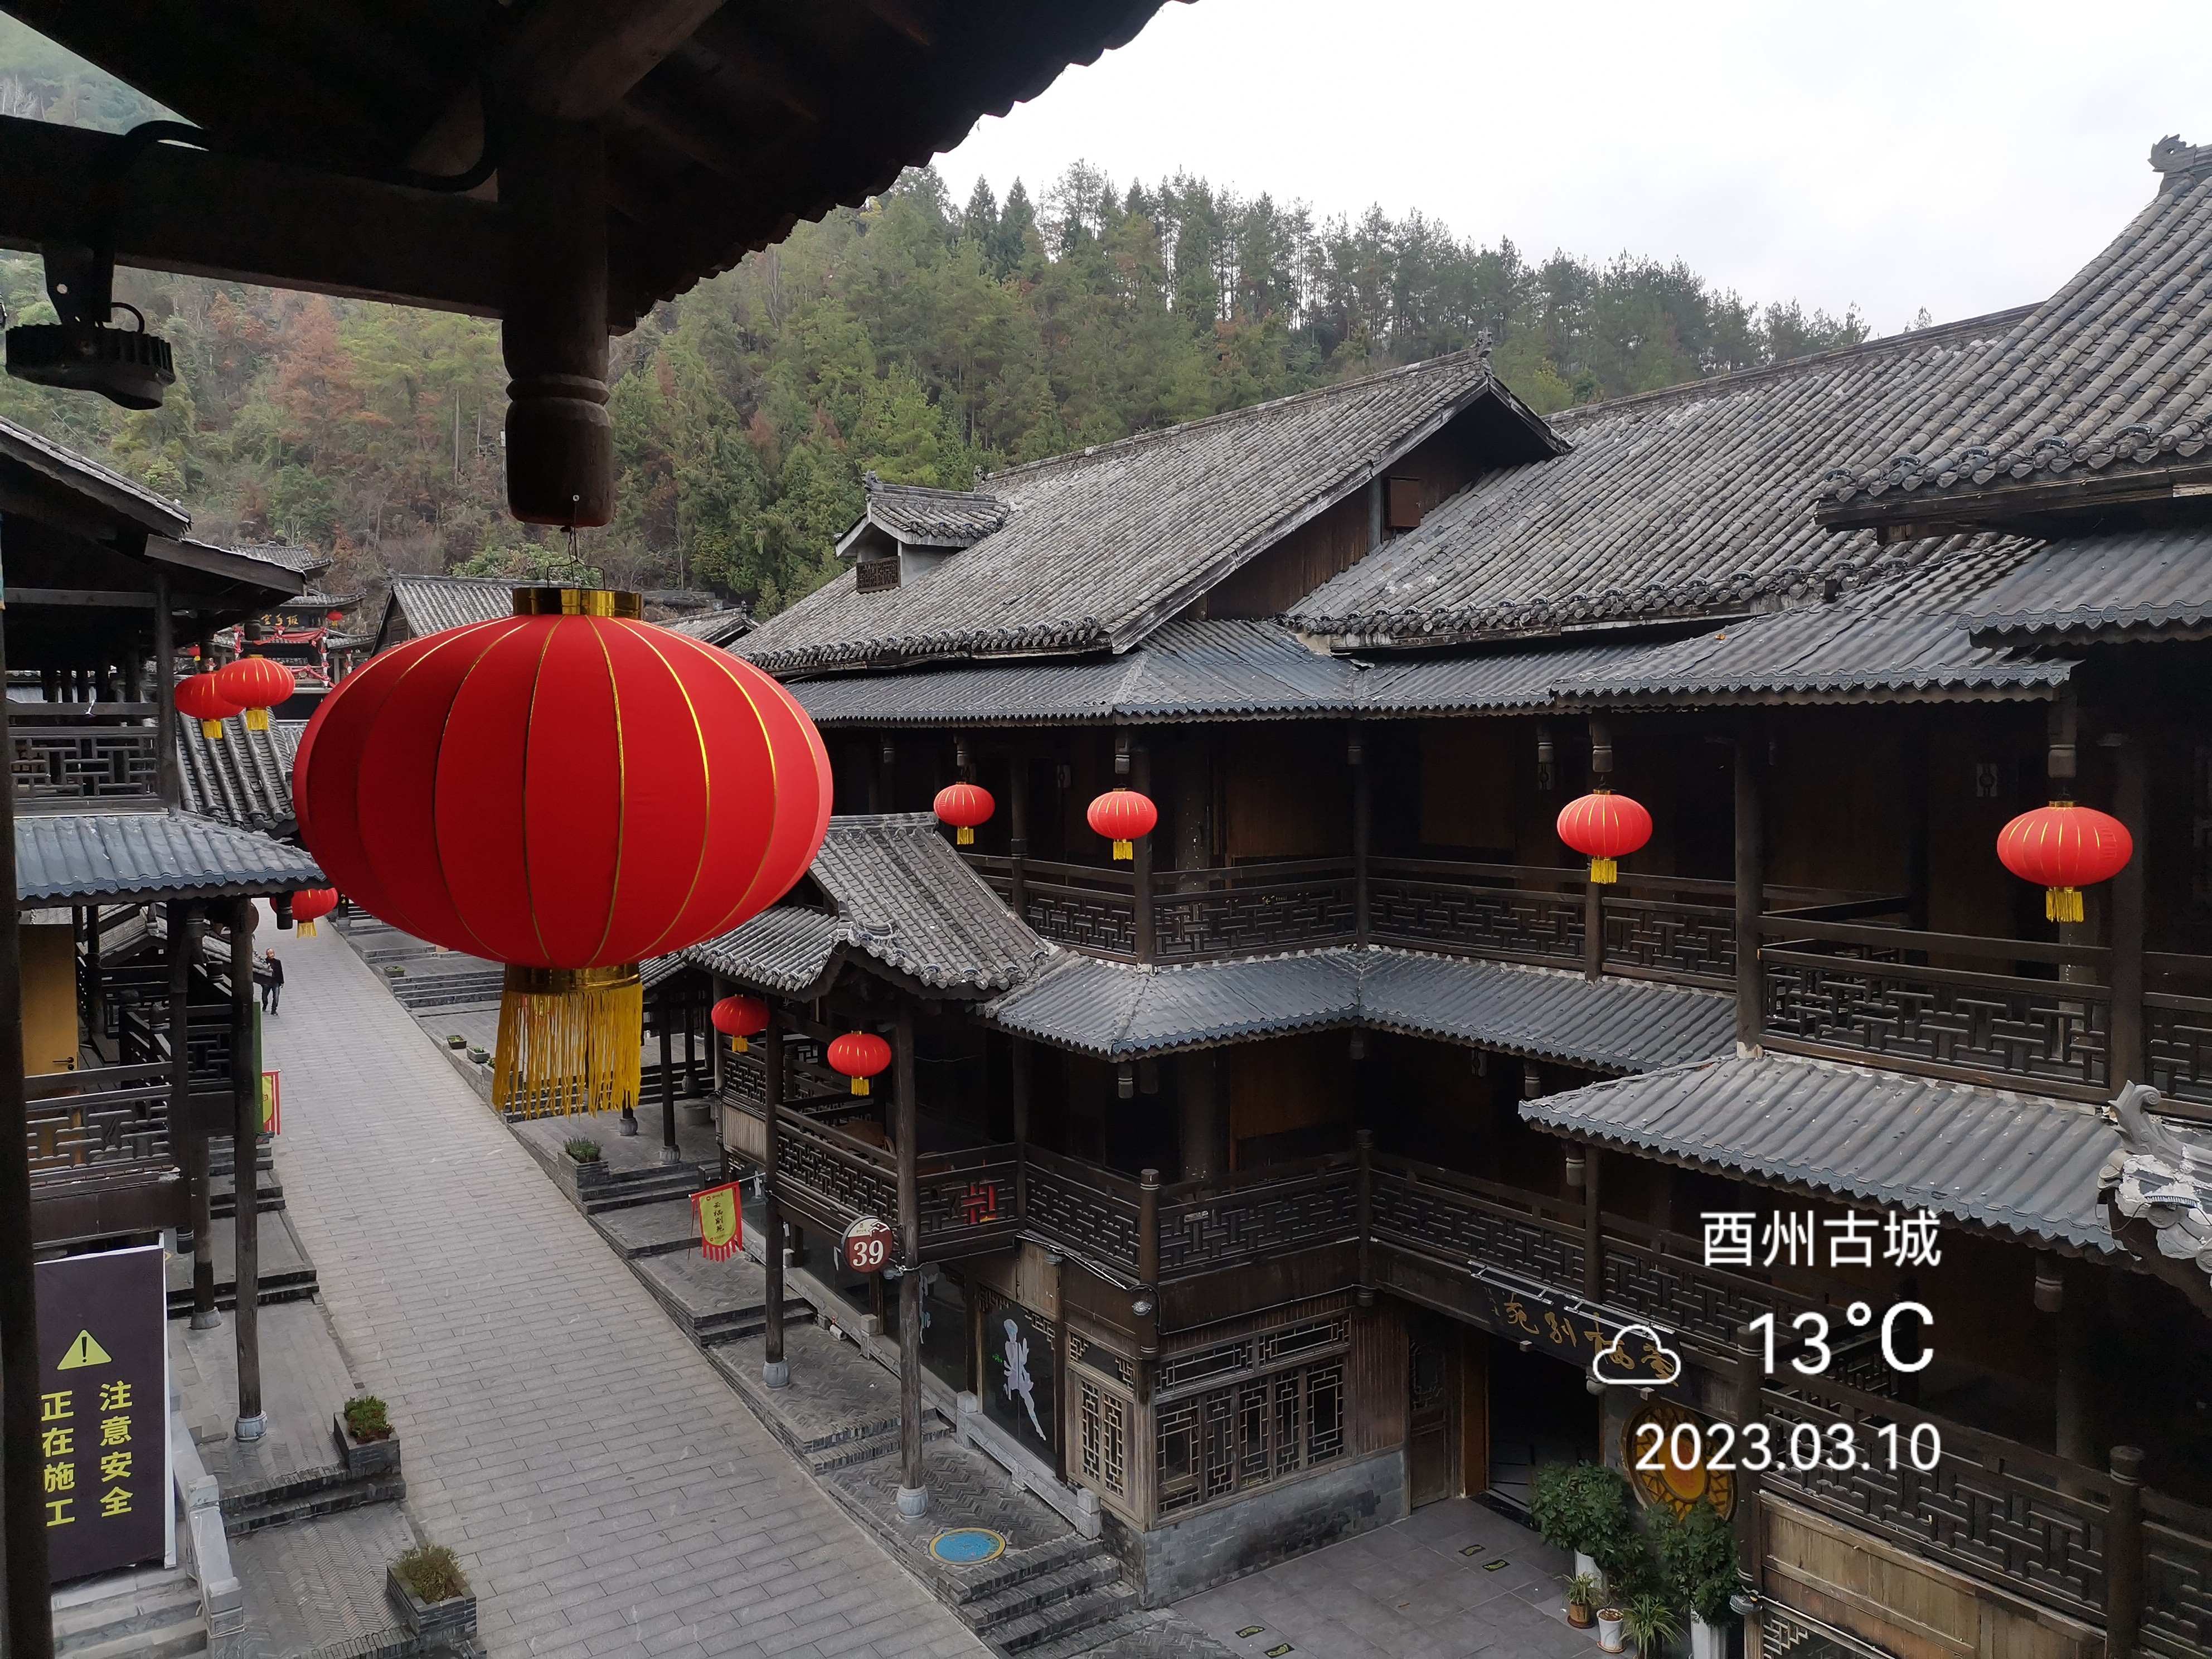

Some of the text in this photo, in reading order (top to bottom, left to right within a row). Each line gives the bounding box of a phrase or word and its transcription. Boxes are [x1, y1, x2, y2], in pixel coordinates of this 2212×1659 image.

[852, 1239, 884, 1267] 39
[41, 1390, 75, 1527] 正在施工
[99, 1380, 133, 1518] 注意安全
